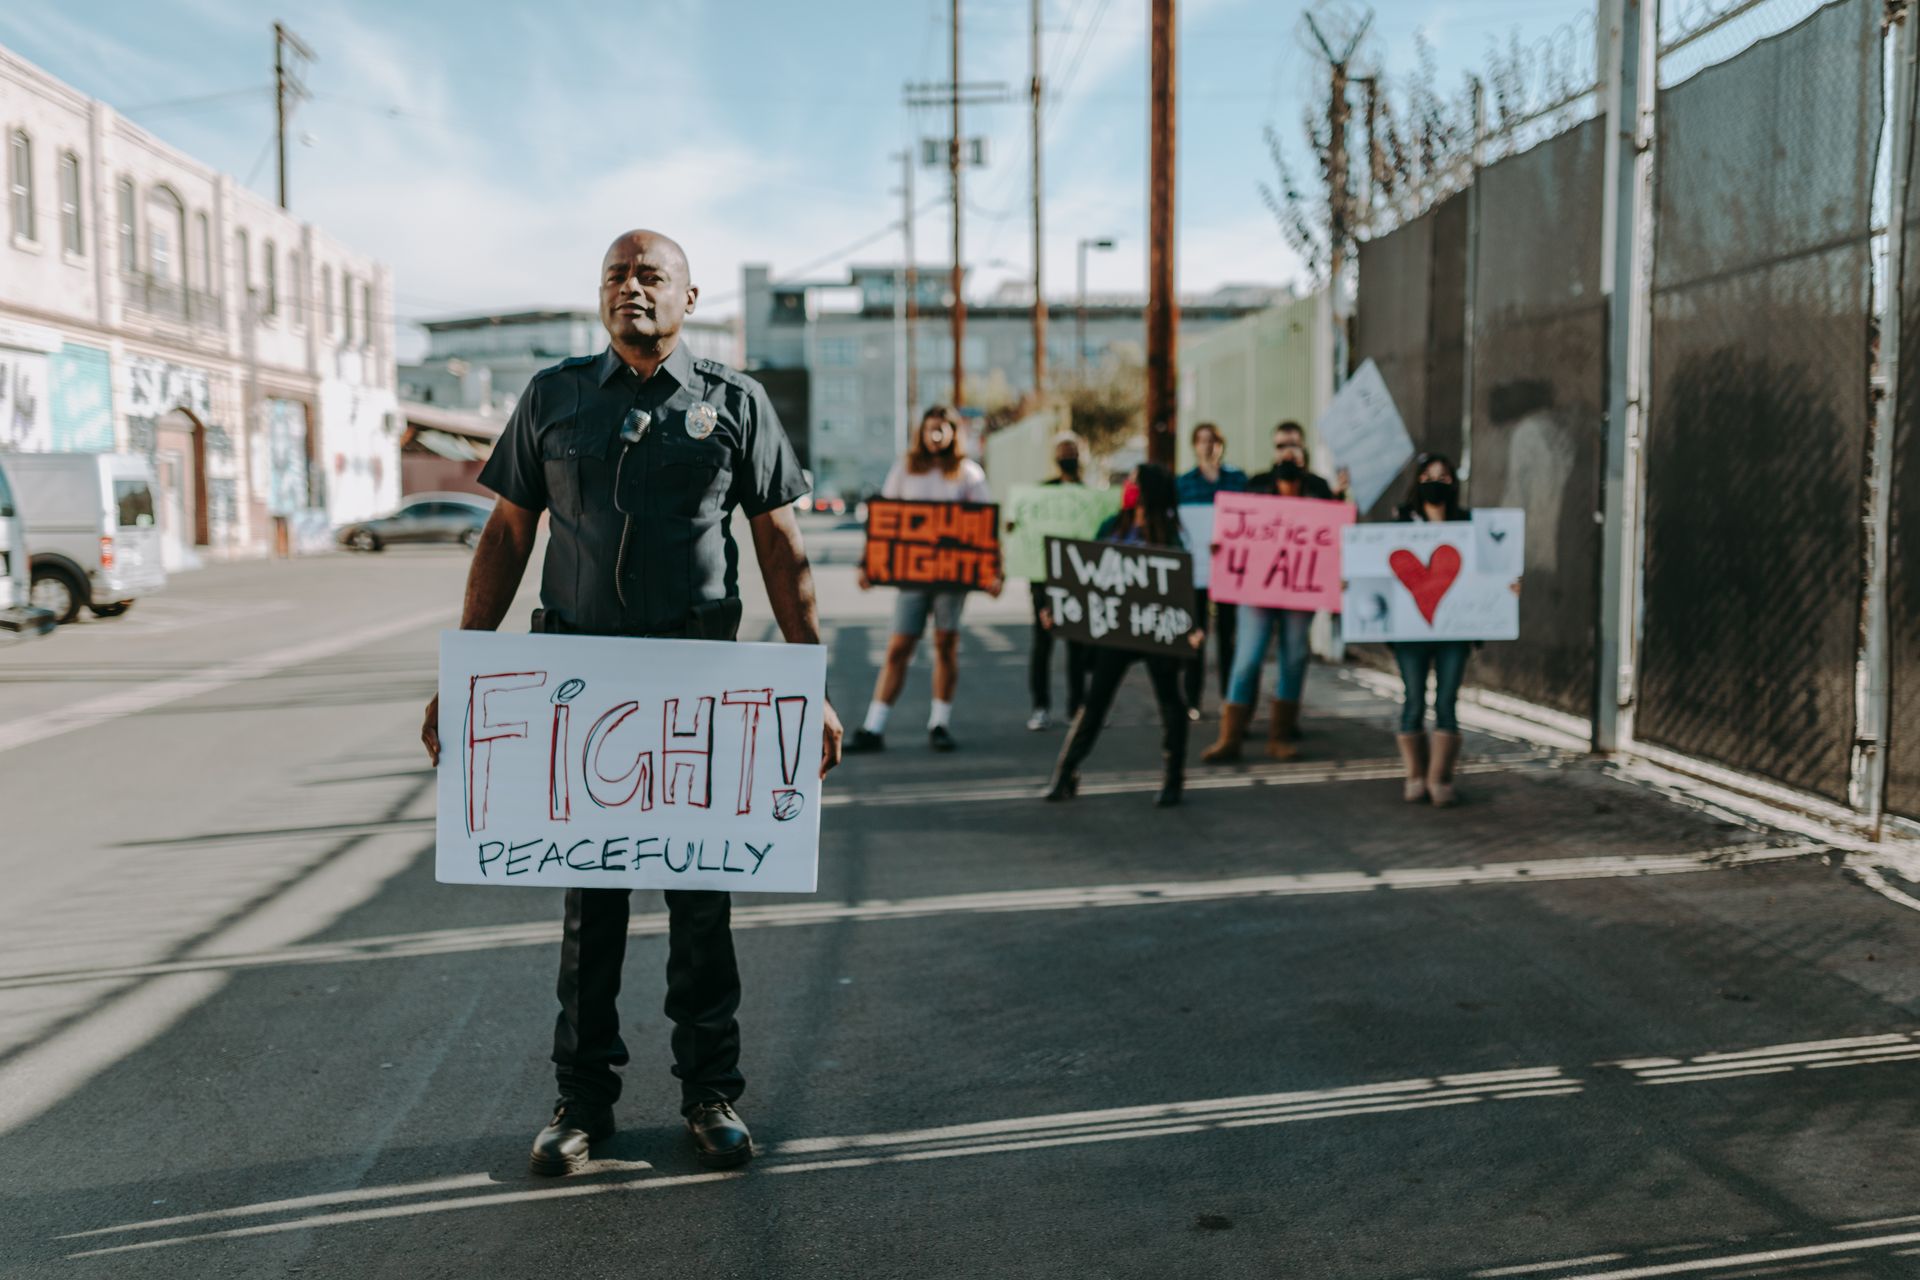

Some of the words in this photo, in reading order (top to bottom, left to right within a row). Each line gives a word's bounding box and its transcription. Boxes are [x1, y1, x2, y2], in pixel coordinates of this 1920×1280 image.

[869, 501, 998, 548] EQUAL
[1222, 507, 1333, 546] Justice
[867, 540, 1000, 588] RIGHTS
[1050, 539, 1062, 580] I
[1066, 543, 1181, 596] WANT
[1228, 548, 1249, 590] 4
[1263, 548, 1323, 593] ALL
[1045, 586, 1083, 627] TO
[1087, 590, 1122, 639] BE
[478, 837, 775, 878] PEACEFULLY
